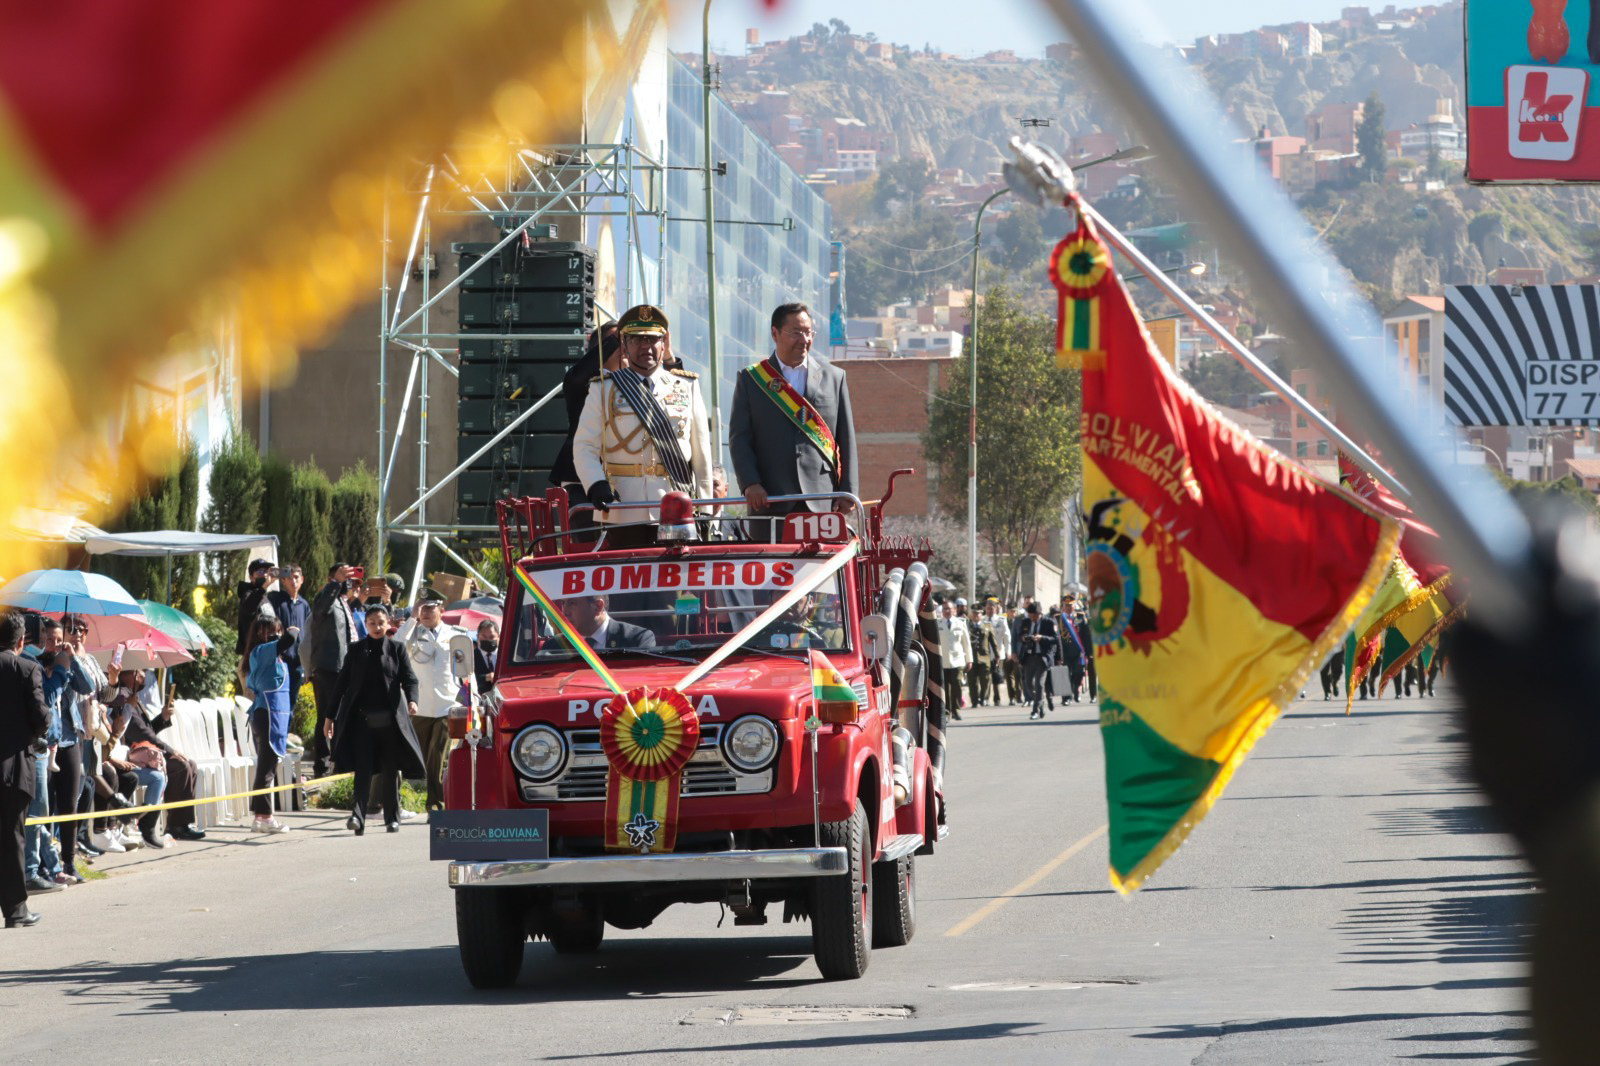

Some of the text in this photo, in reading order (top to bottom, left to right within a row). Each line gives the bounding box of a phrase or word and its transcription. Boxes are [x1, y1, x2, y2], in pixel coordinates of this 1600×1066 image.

[569, 258, 580, 269] 17
[566, 293, 581, 305] 22
[1529, 363, 1600, 386] DISP
[1534, 392, 1600, 415] 77 7
[789, 514, 840, 540] 119
[562, 561, 795, 595] BOMBEROS
[449, 826, 540, 839] POLICÍA BOLIVIANA
